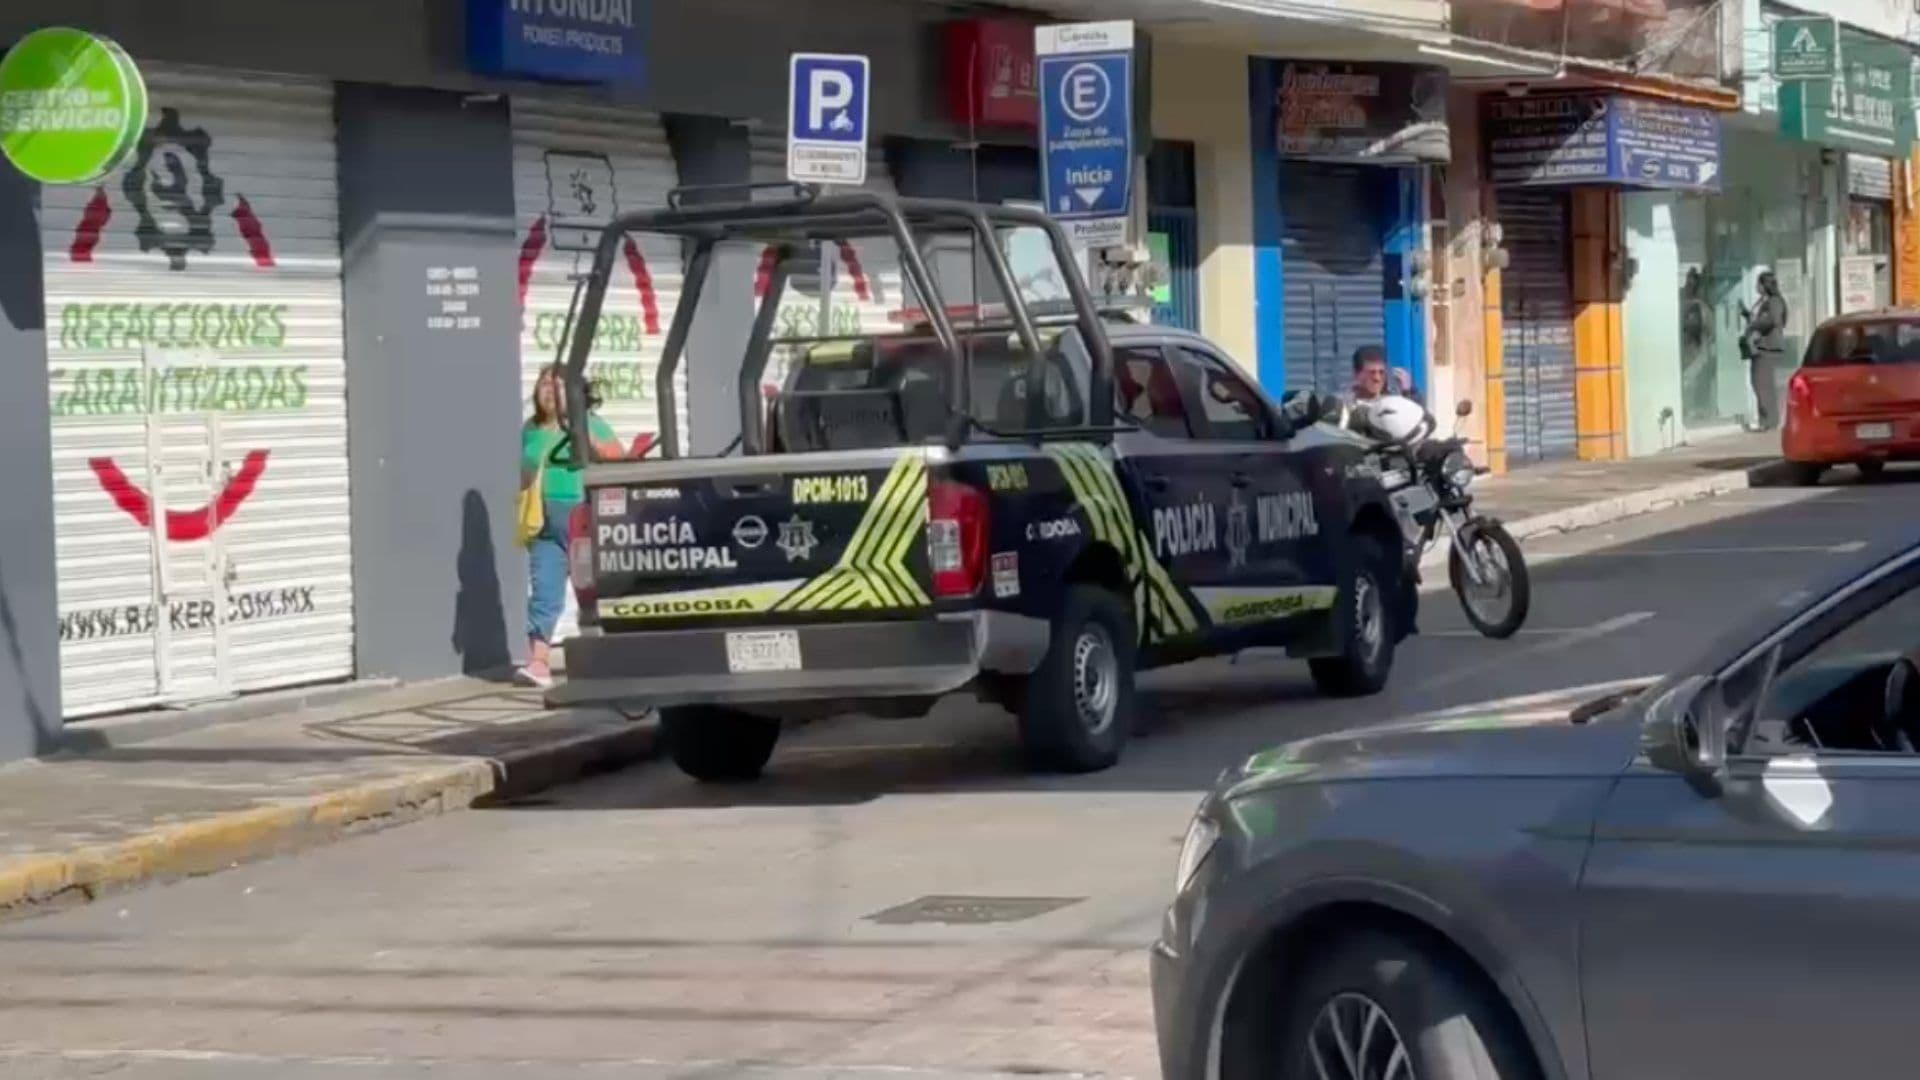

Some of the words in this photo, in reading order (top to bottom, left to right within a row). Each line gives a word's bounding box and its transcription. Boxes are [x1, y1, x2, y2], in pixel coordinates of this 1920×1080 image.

[1073, 75, 1097, 109] E
[1, 107, 121, 131] SERVICIO
[1065, 165, 1114, 185] Inicia
[60, 303, 289, 349] REFACCIONES
[534, 312, 642, 352] COPRA
[793, 476, 868, 505] DPCM-1013
[598, 515, 697, 546] POLICÍA
[599, 544, 738, 572] MUNICIPAL
[58, 584, 315, 641] WWW.RAKER.COM.MX
